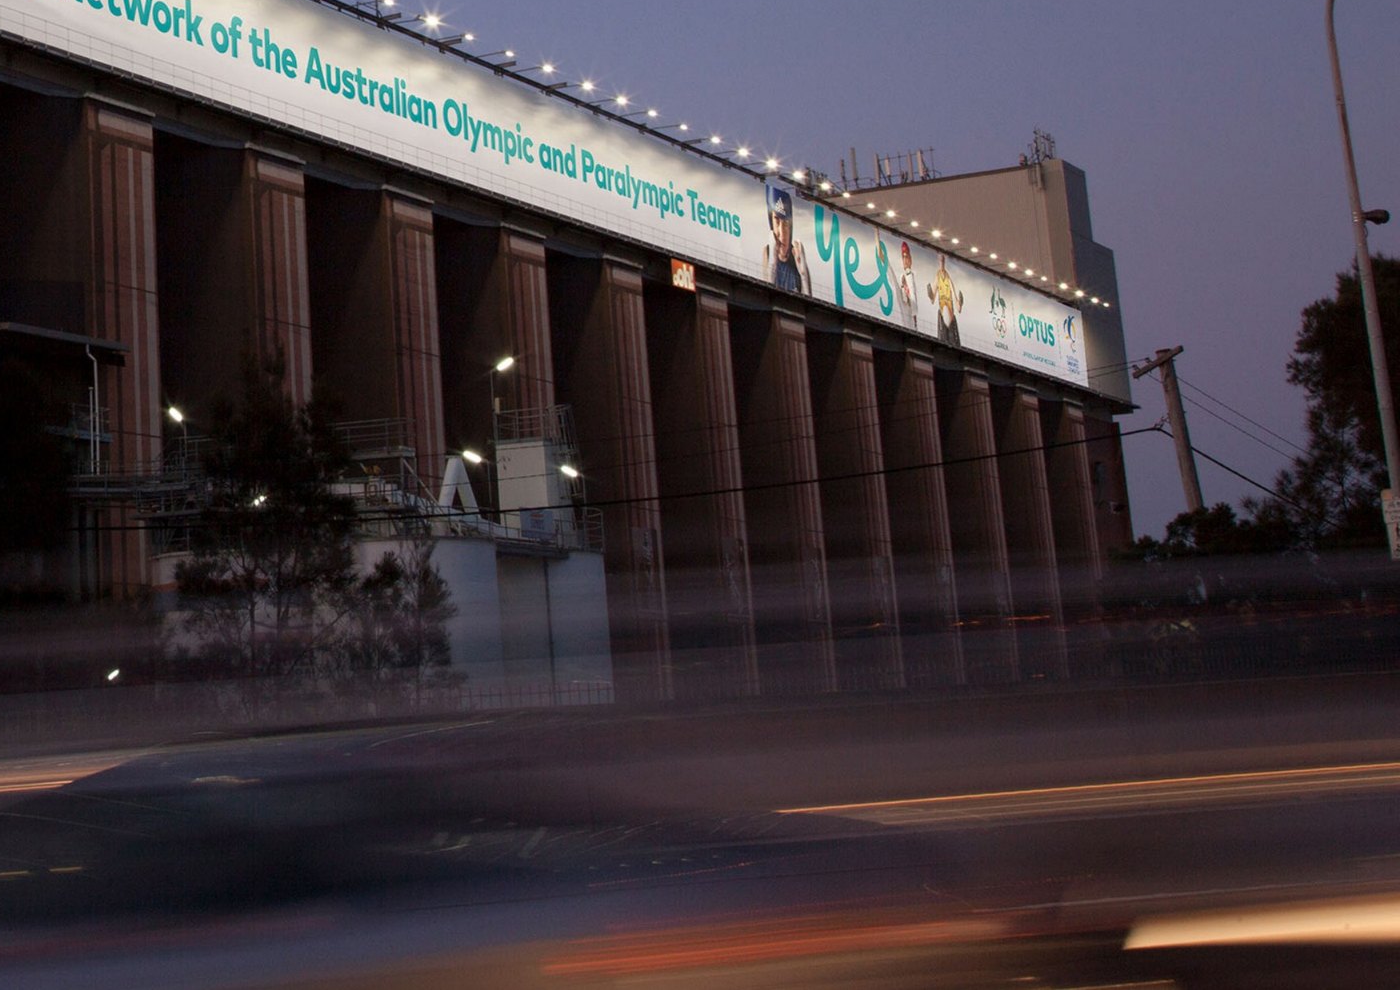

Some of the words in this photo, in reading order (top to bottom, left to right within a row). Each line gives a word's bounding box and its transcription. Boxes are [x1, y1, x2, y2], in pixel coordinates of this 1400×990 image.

[210, 16, 242, 58] of
[248, 28, 298, 79] the
[304, 46, 438, 129] Australian
[443, 98, 534, 164] Olympic
[538, 144, 577, 179] and
[581, 149, 685, 218] Paralympic
[686, 189, 741, 238] Teams
[814, 204, 894, 317] yes
[1018, 313, 1056, 347] OPTUS
